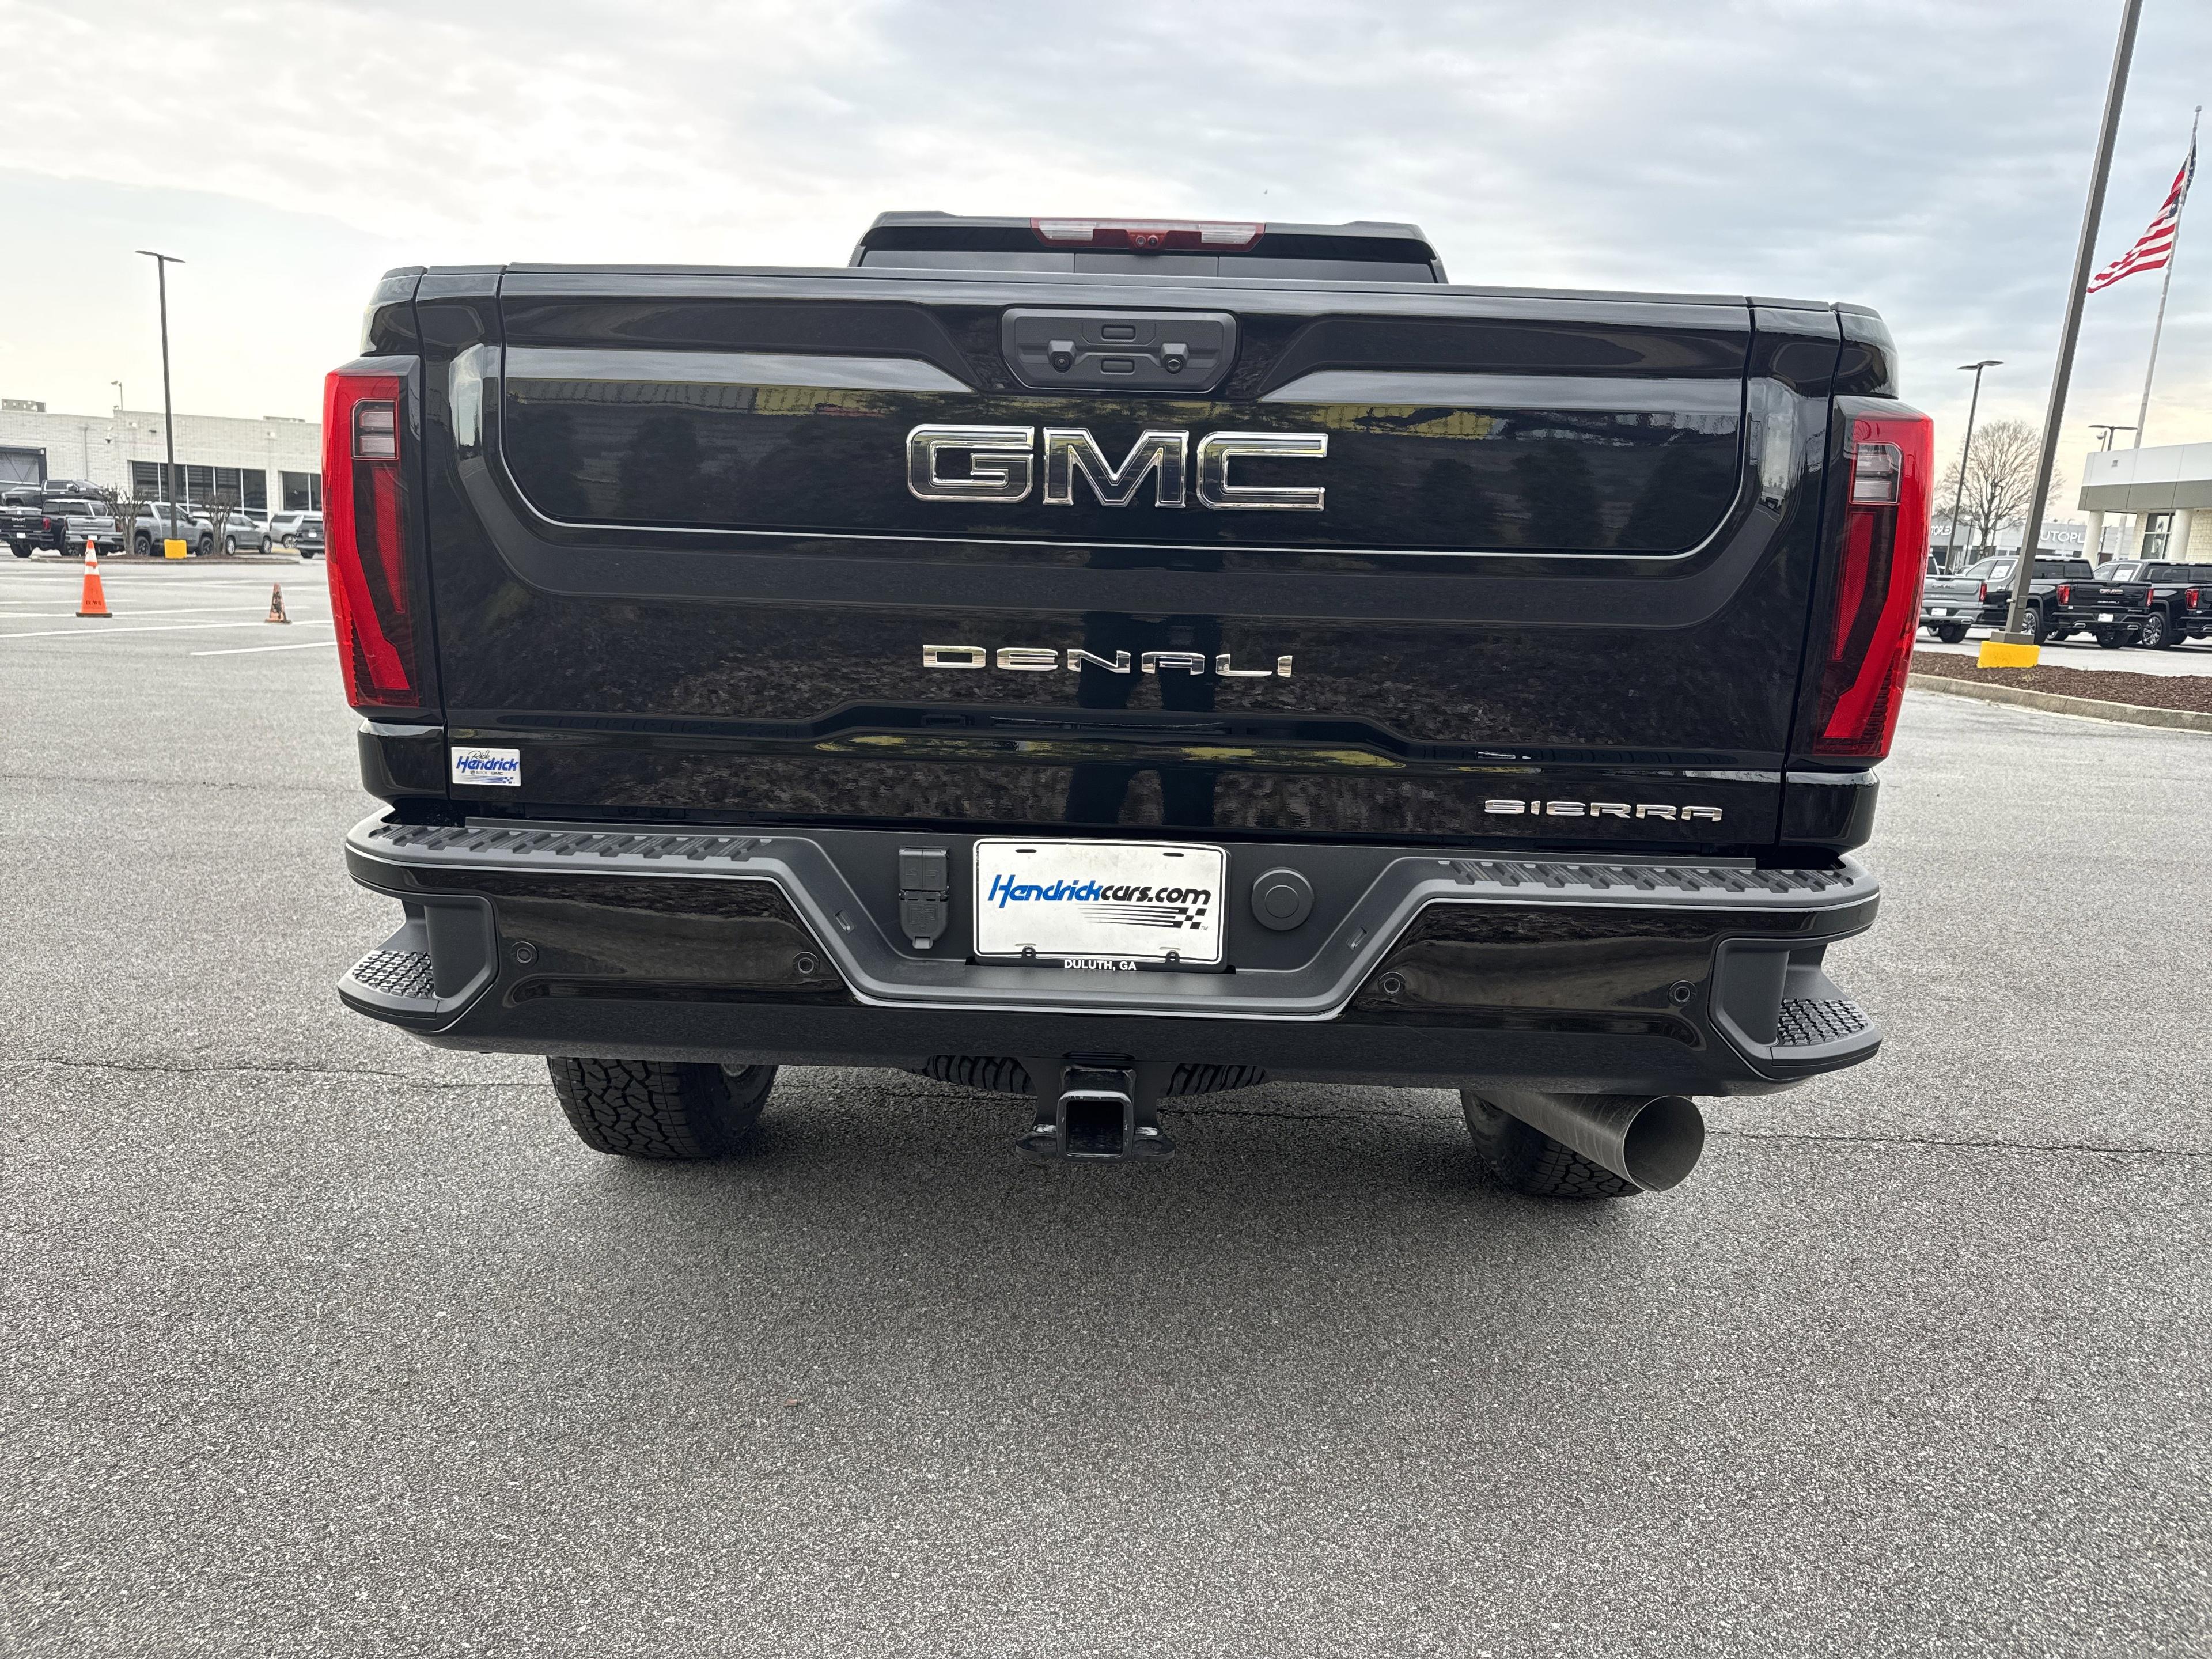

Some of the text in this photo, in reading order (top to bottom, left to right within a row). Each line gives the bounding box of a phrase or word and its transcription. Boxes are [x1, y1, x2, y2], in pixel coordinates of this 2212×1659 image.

[906, 423, 1328, 512] GMC
[2040, 531, 2086, 543] UTOPL
[923, 645, 1293, 678] DENALI
[456, 756, 519, 774] Hendrick
[468, 750, 490, 763] Rick
[1484, 800, 1723, 822] SIERRA
[987, 874, 1211, 909] Hendrickcars.com
[1064, 959, 1137, 971] DULUTH, GA
